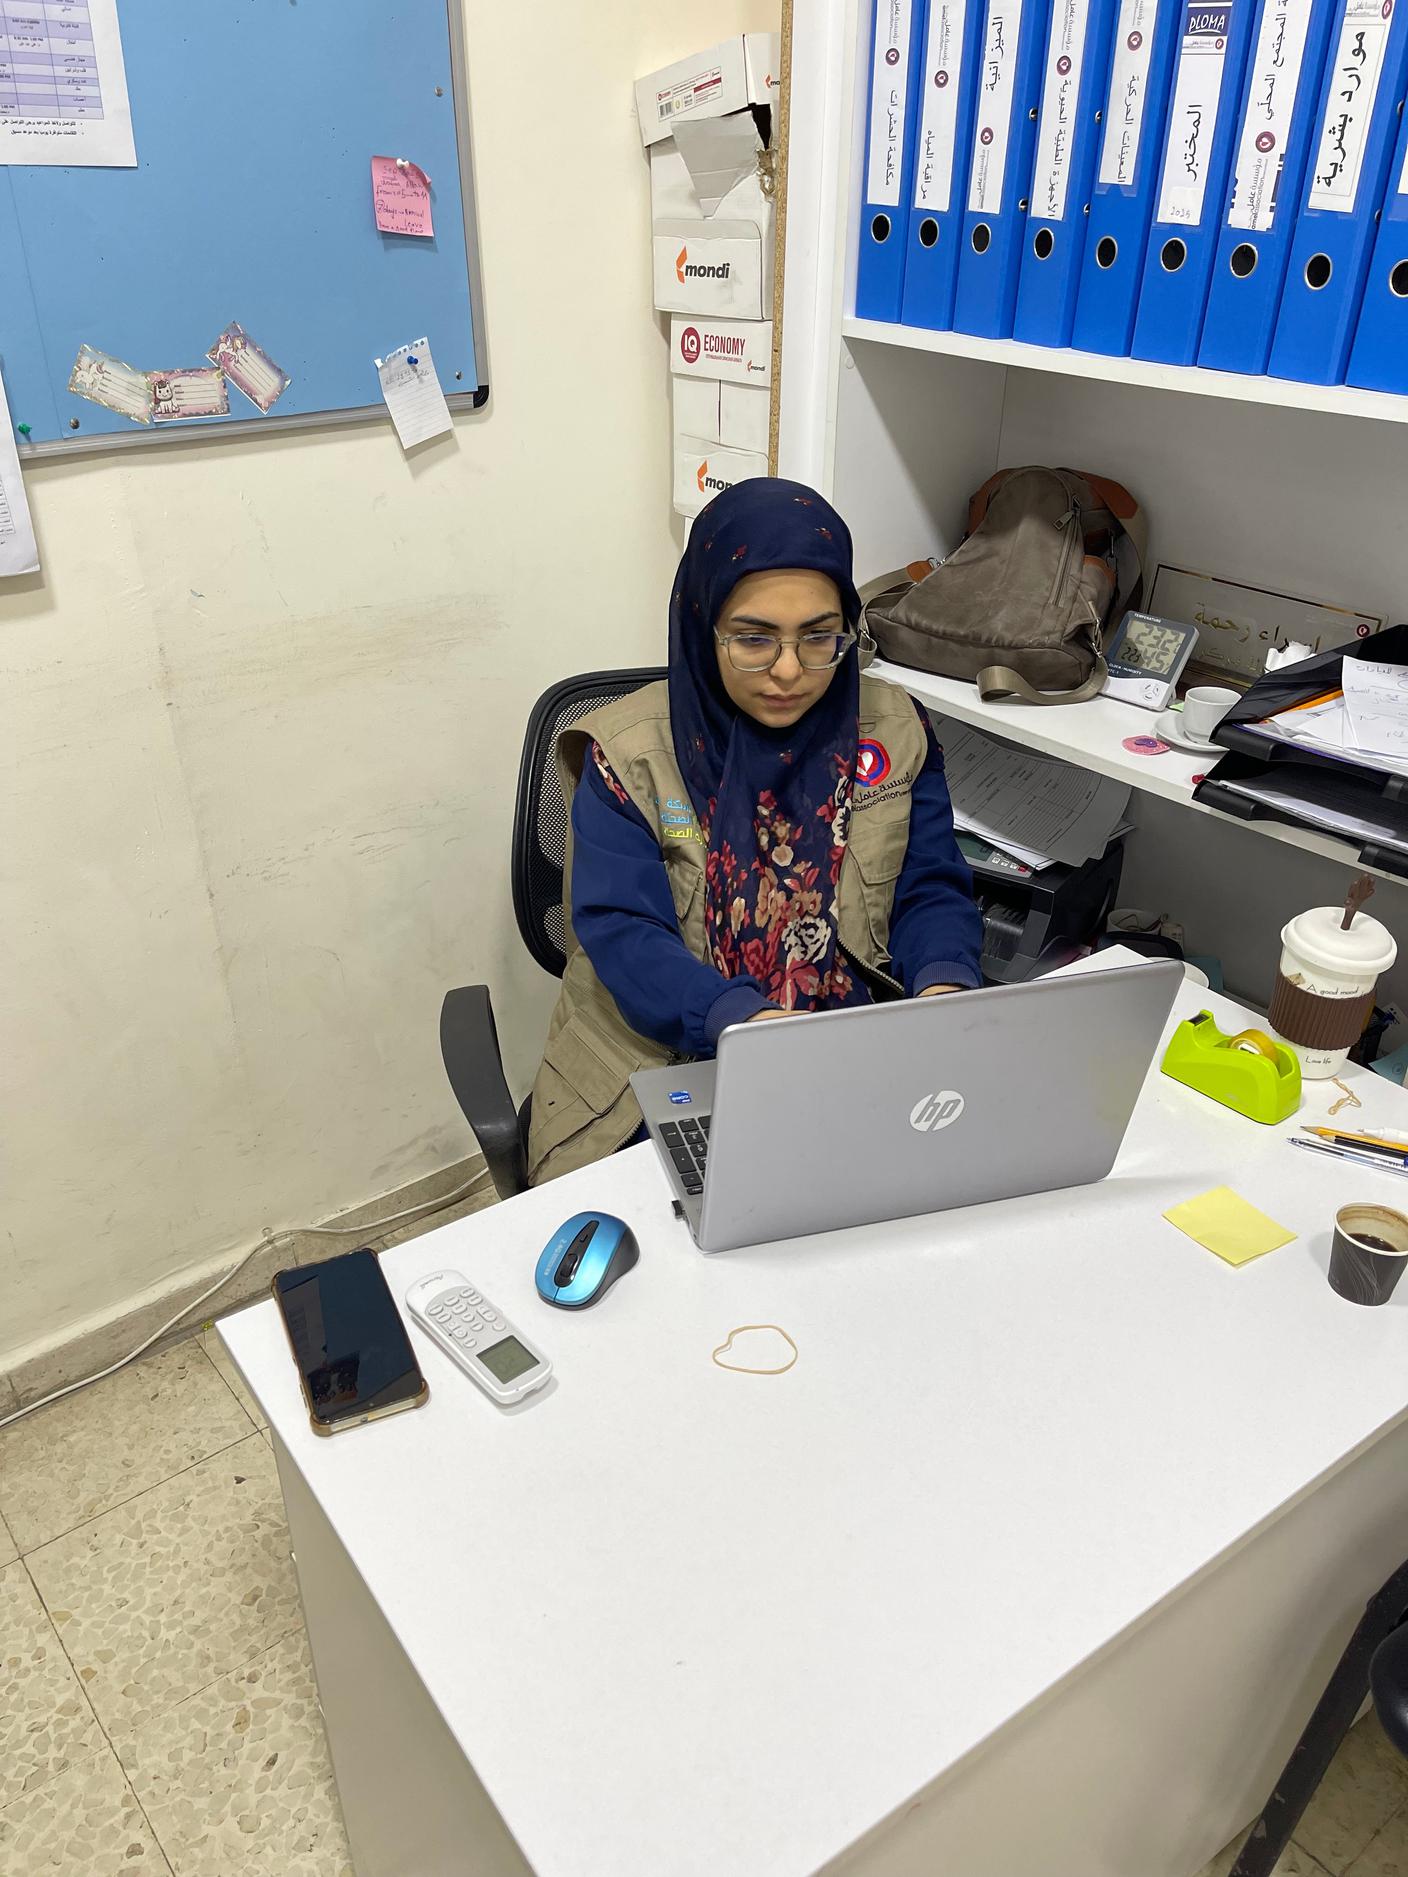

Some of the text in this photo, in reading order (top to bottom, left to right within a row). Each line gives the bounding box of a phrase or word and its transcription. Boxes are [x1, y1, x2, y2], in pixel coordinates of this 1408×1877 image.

[1273, 13, 1287, 67] المجتمع
[1341, 31, 1366, 102] موارد
[1058, 79, 1072, 124] الحيوية
[1125, 75, 1139, 125] الحركية
[885, 89, 898, 186] مكافحة الحشرات
[1184, 104, 1203, 182] المختبر
[1317, 114, 1353, 187] بشرية
[920, 130, 936, 200] مراقبة المياه
[685, 263, 730, 279] mondi
[684, 335, 697, 352] IQ
[704, 335, 745, 356] ECONOMY
[1320, 987, 1338, 995] good
[910, 1090, 964, 1131] hp
